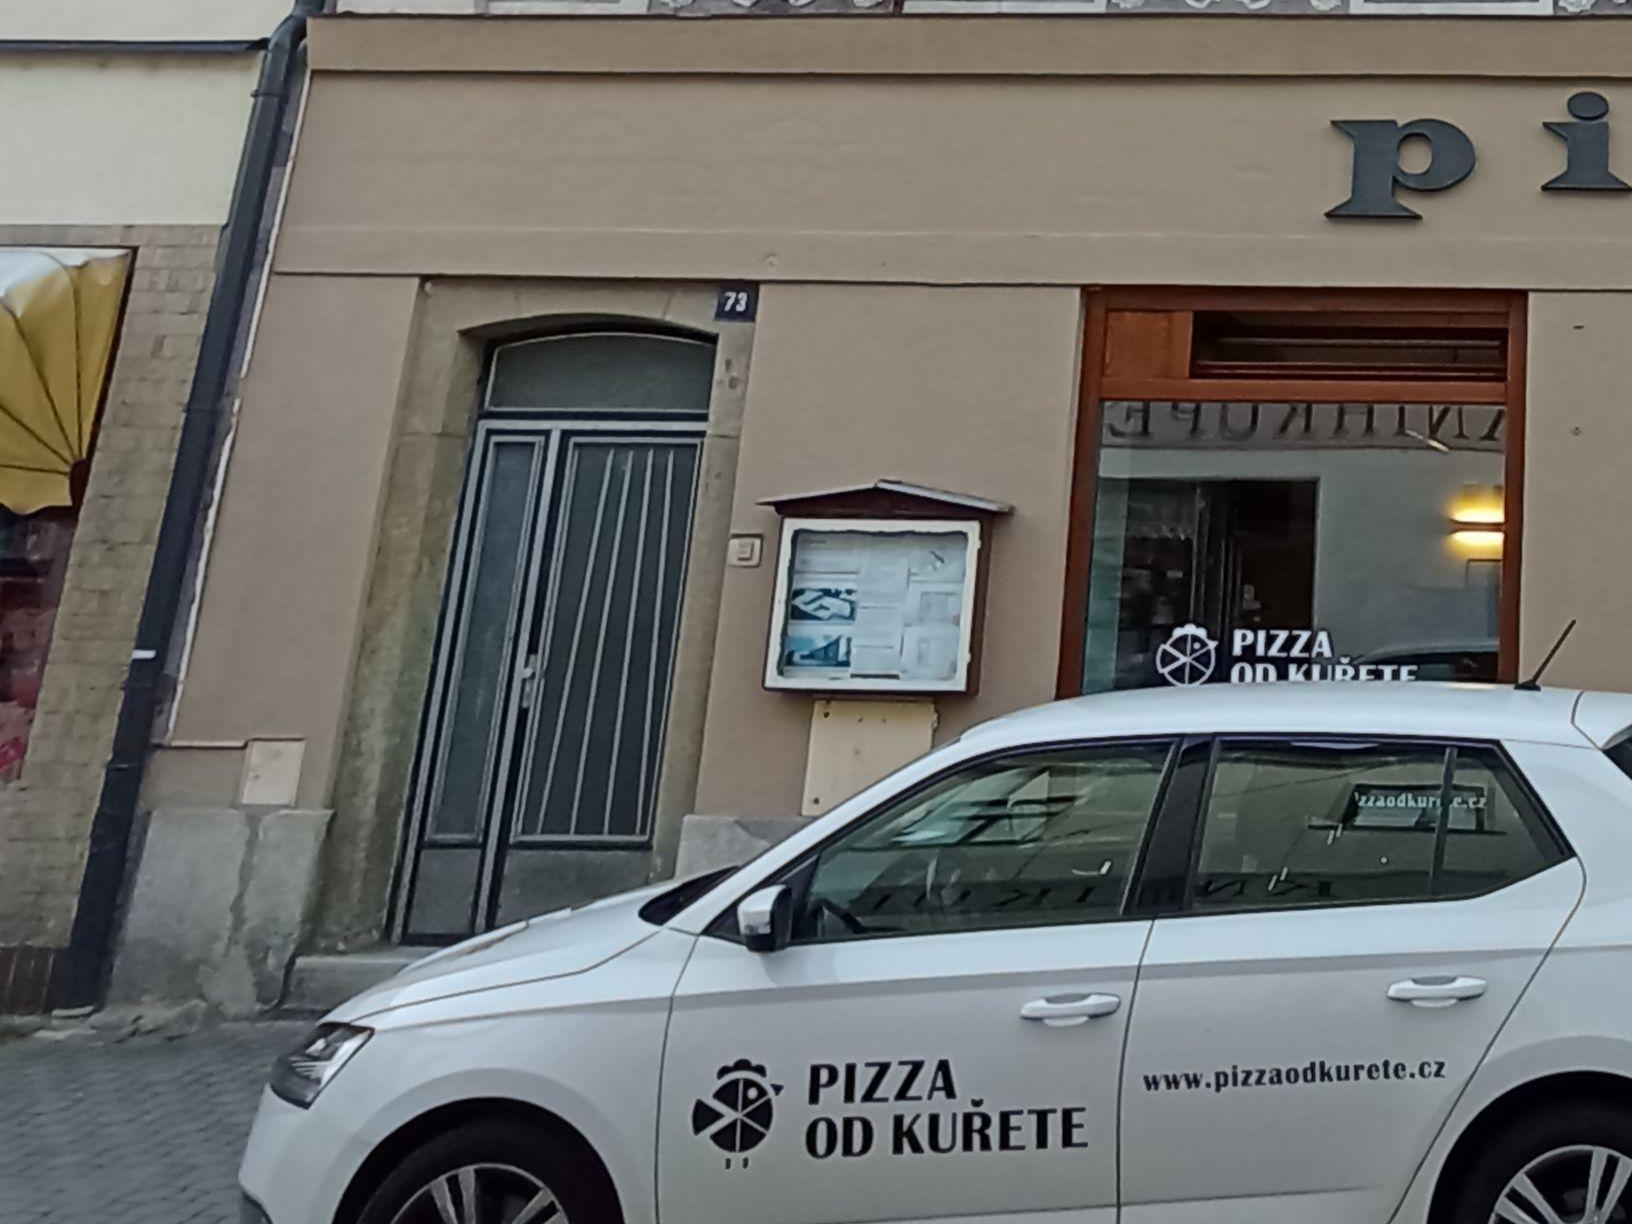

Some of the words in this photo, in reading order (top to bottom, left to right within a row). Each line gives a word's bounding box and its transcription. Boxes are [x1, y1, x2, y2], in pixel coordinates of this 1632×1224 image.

[724, 291, 748, 312] 73
[1231, 629, 1333, 658] PIZZA
[1230, 662, 1277, 684] OD
[808, 1059, 957, 1105] PIZZA
[1143, 1059, 1446, 1094] www.pizzaodkurete.cz
[805, 1116, 874, 1159] OD
[892, 1098, 1089, 1155] KUŘETE
